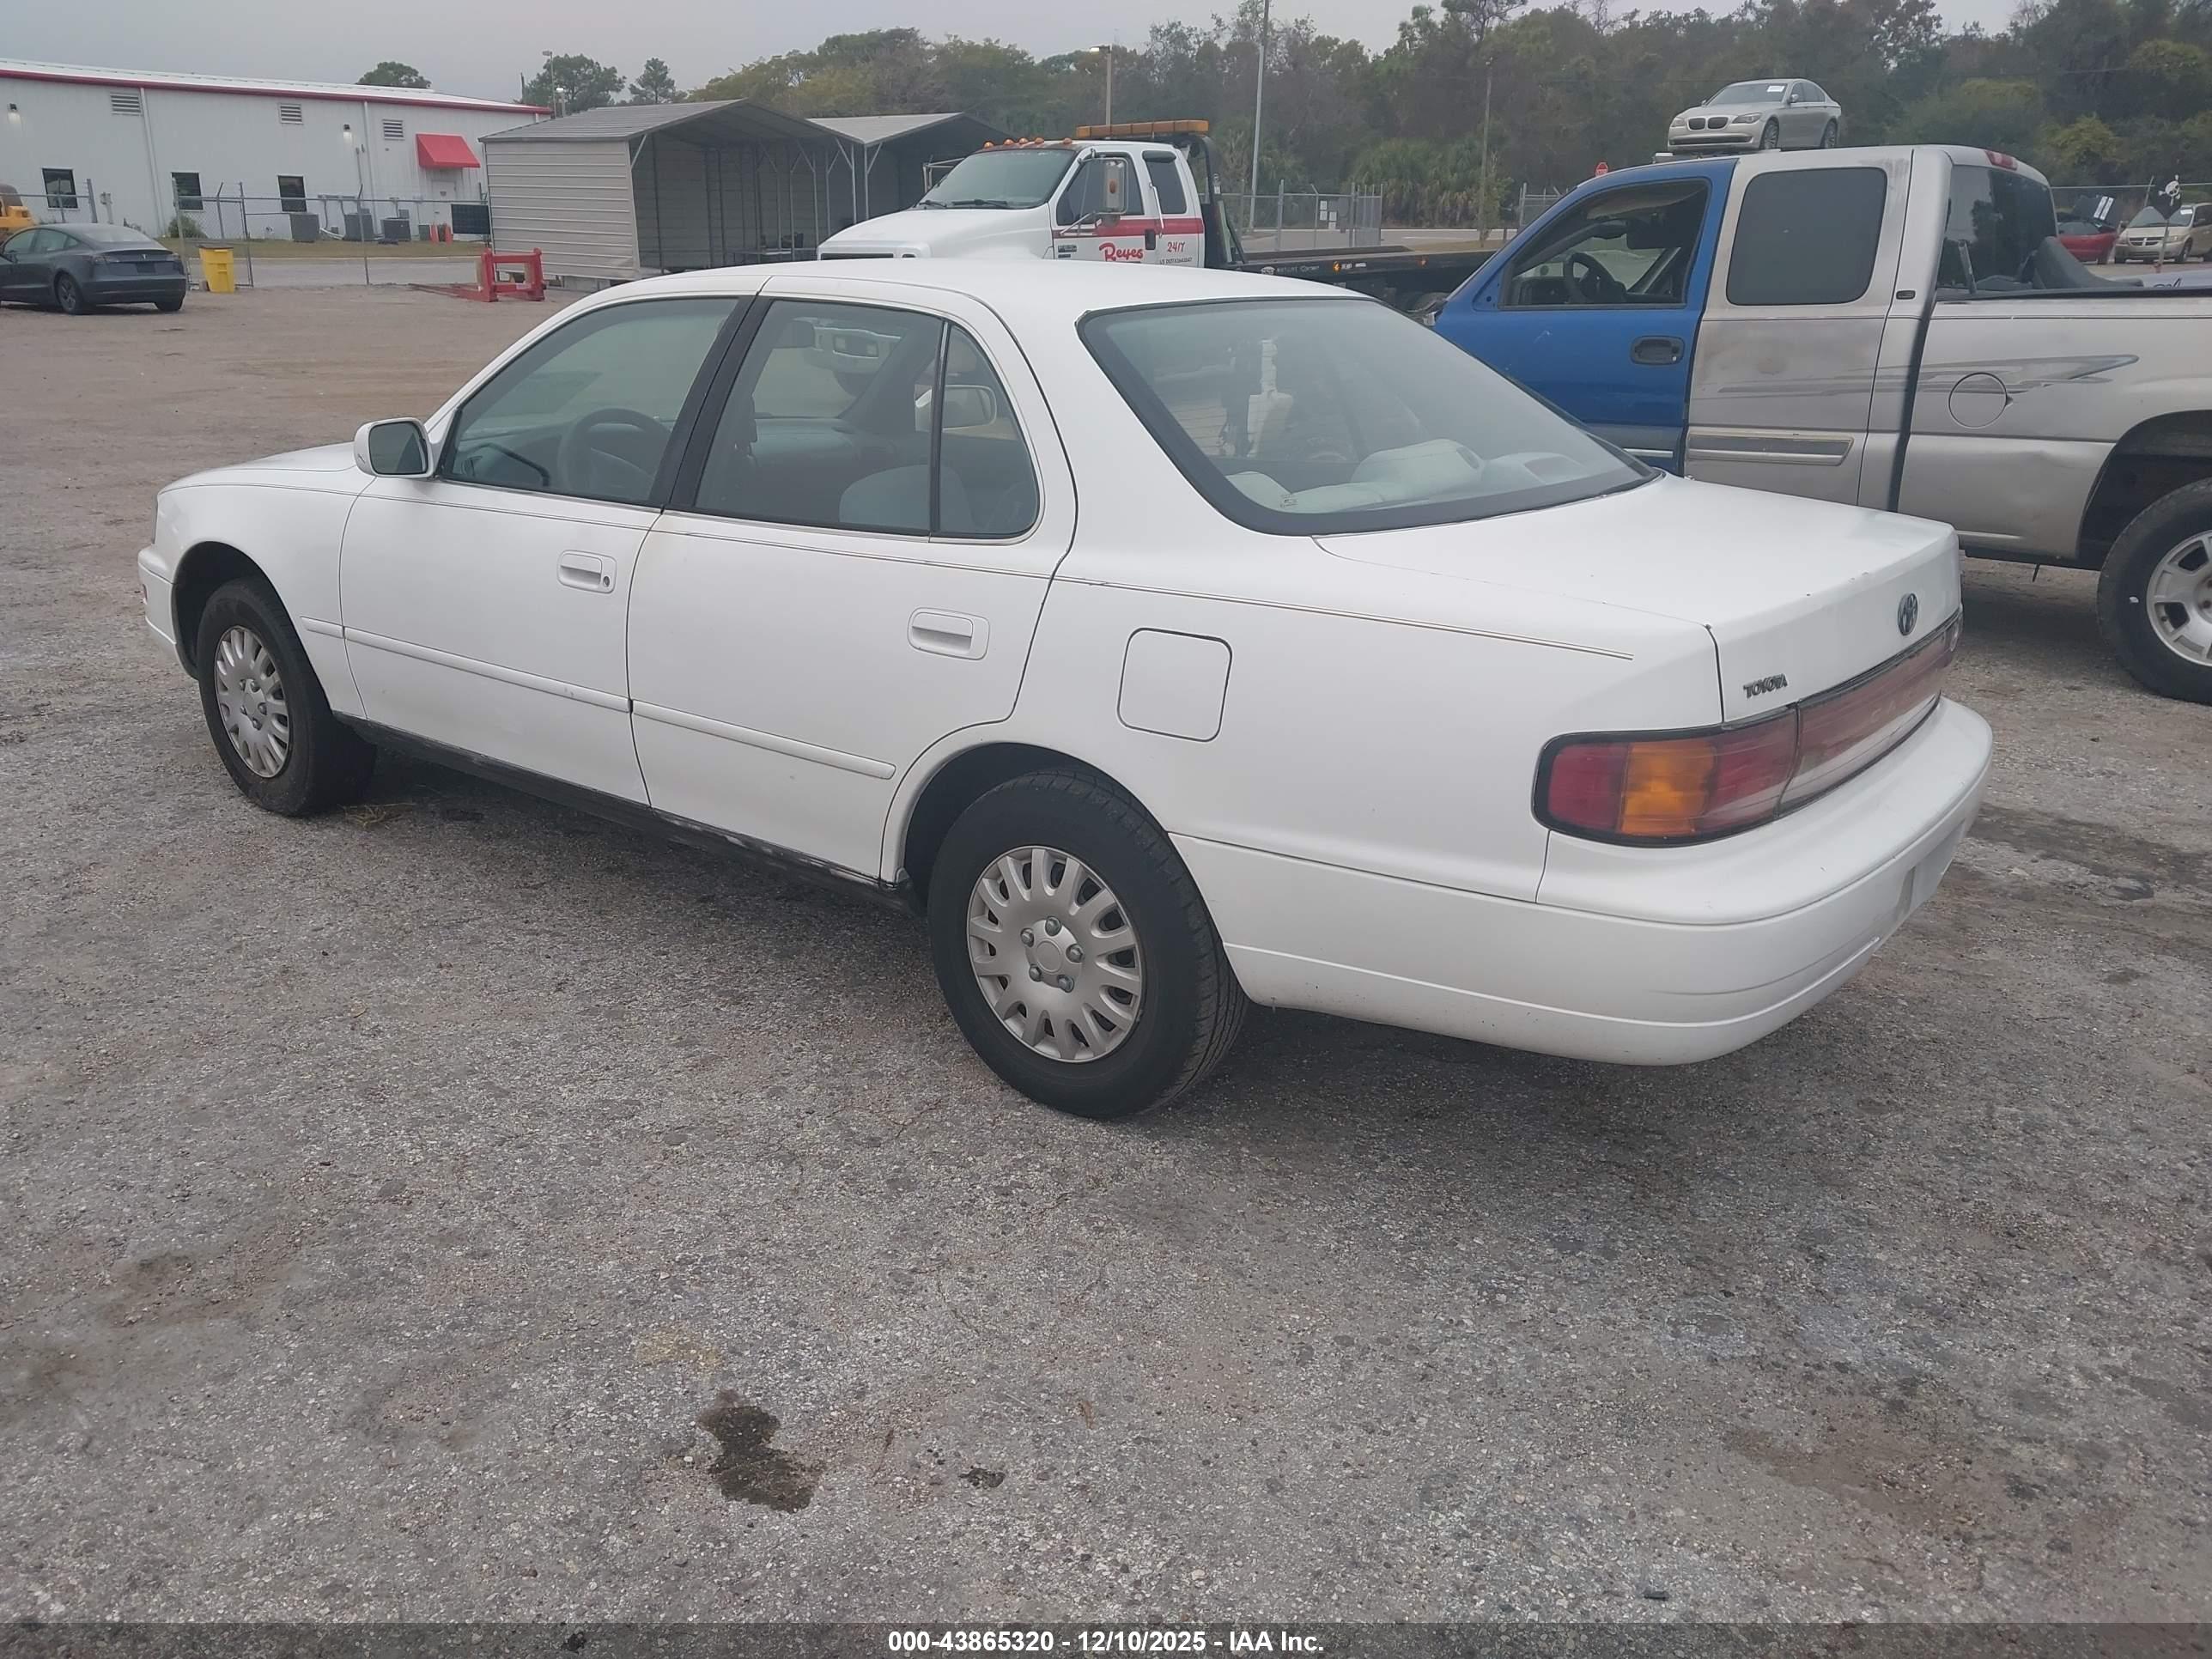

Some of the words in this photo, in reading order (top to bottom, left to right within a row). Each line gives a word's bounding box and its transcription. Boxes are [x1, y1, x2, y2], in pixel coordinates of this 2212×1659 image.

[1099, 242, 1144, 262] Reyes
[1167, 240, 1186, 253] 24/7
[1742, 672, 1788, 699] TOYOTA
